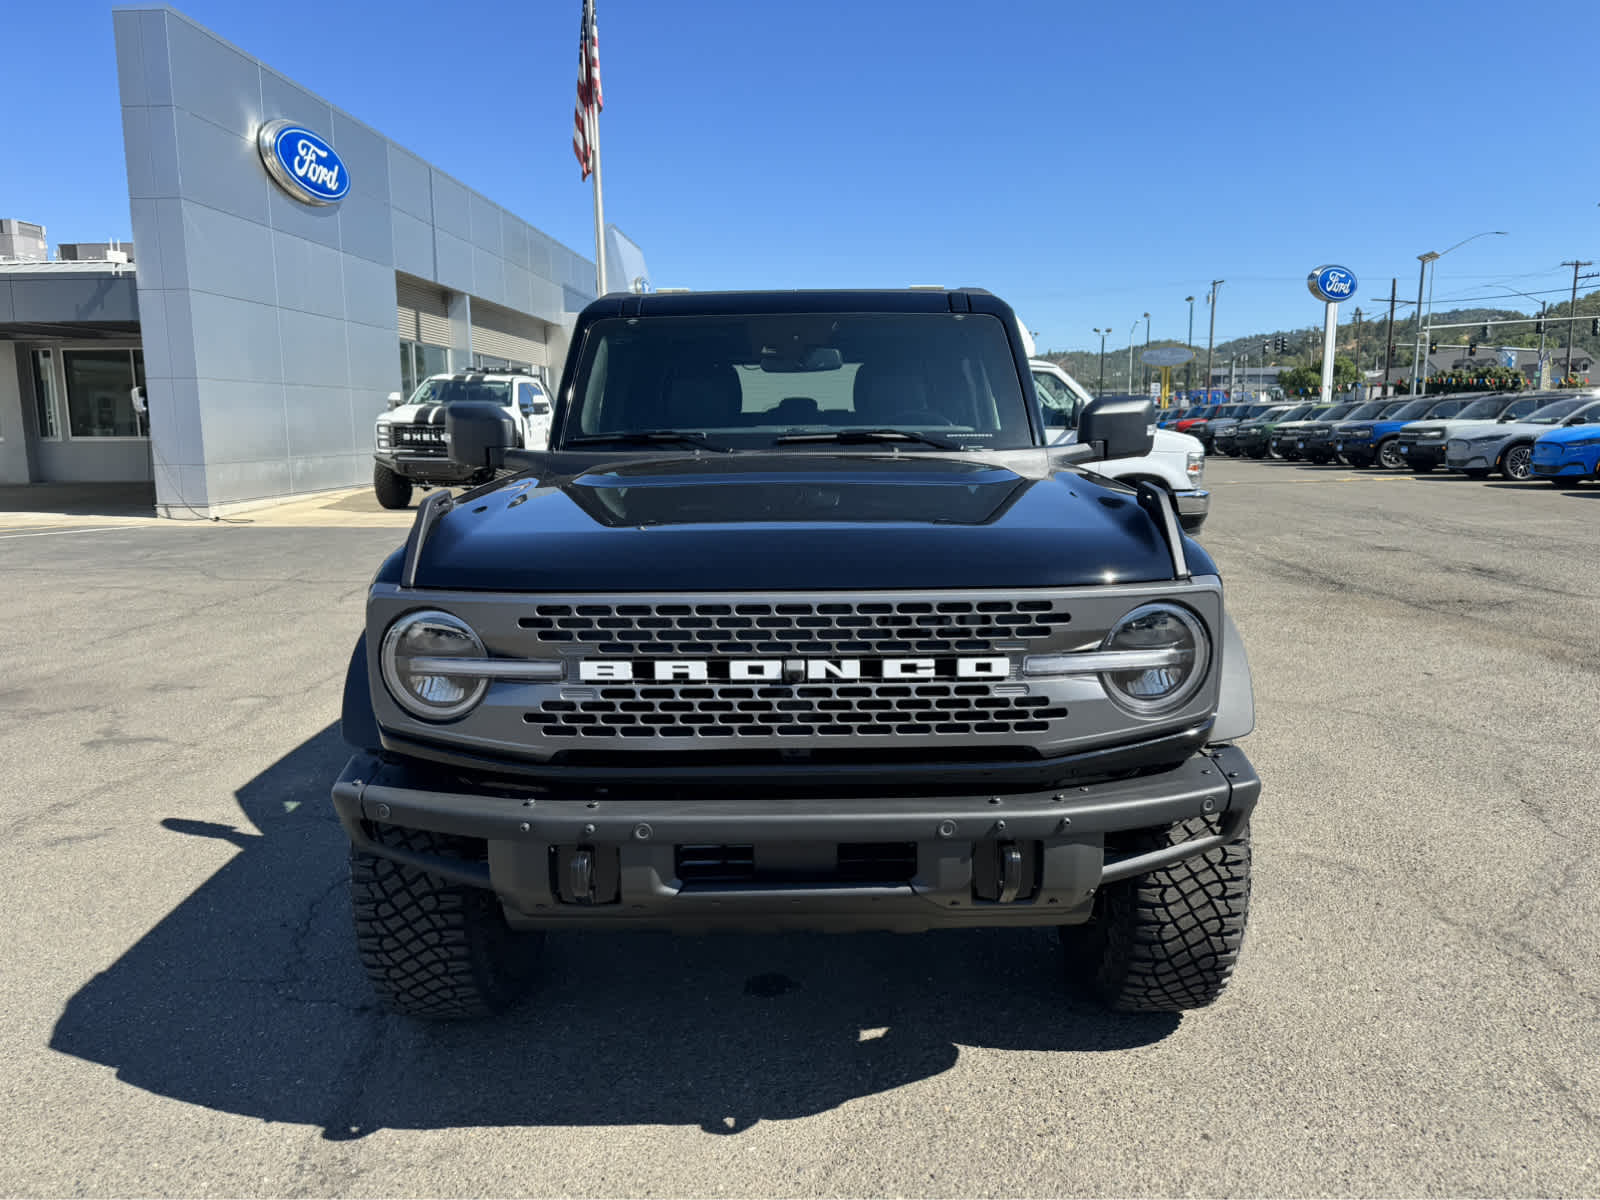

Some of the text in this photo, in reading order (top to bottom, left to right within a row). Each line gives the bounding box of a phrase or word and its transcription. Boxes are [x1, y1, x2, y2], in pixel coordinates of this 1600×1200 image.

[294, 139, 339, 191] Ford
[1326, 271, 1352, 294] Ford
[579, 657, 1010, 680] BRONCO
